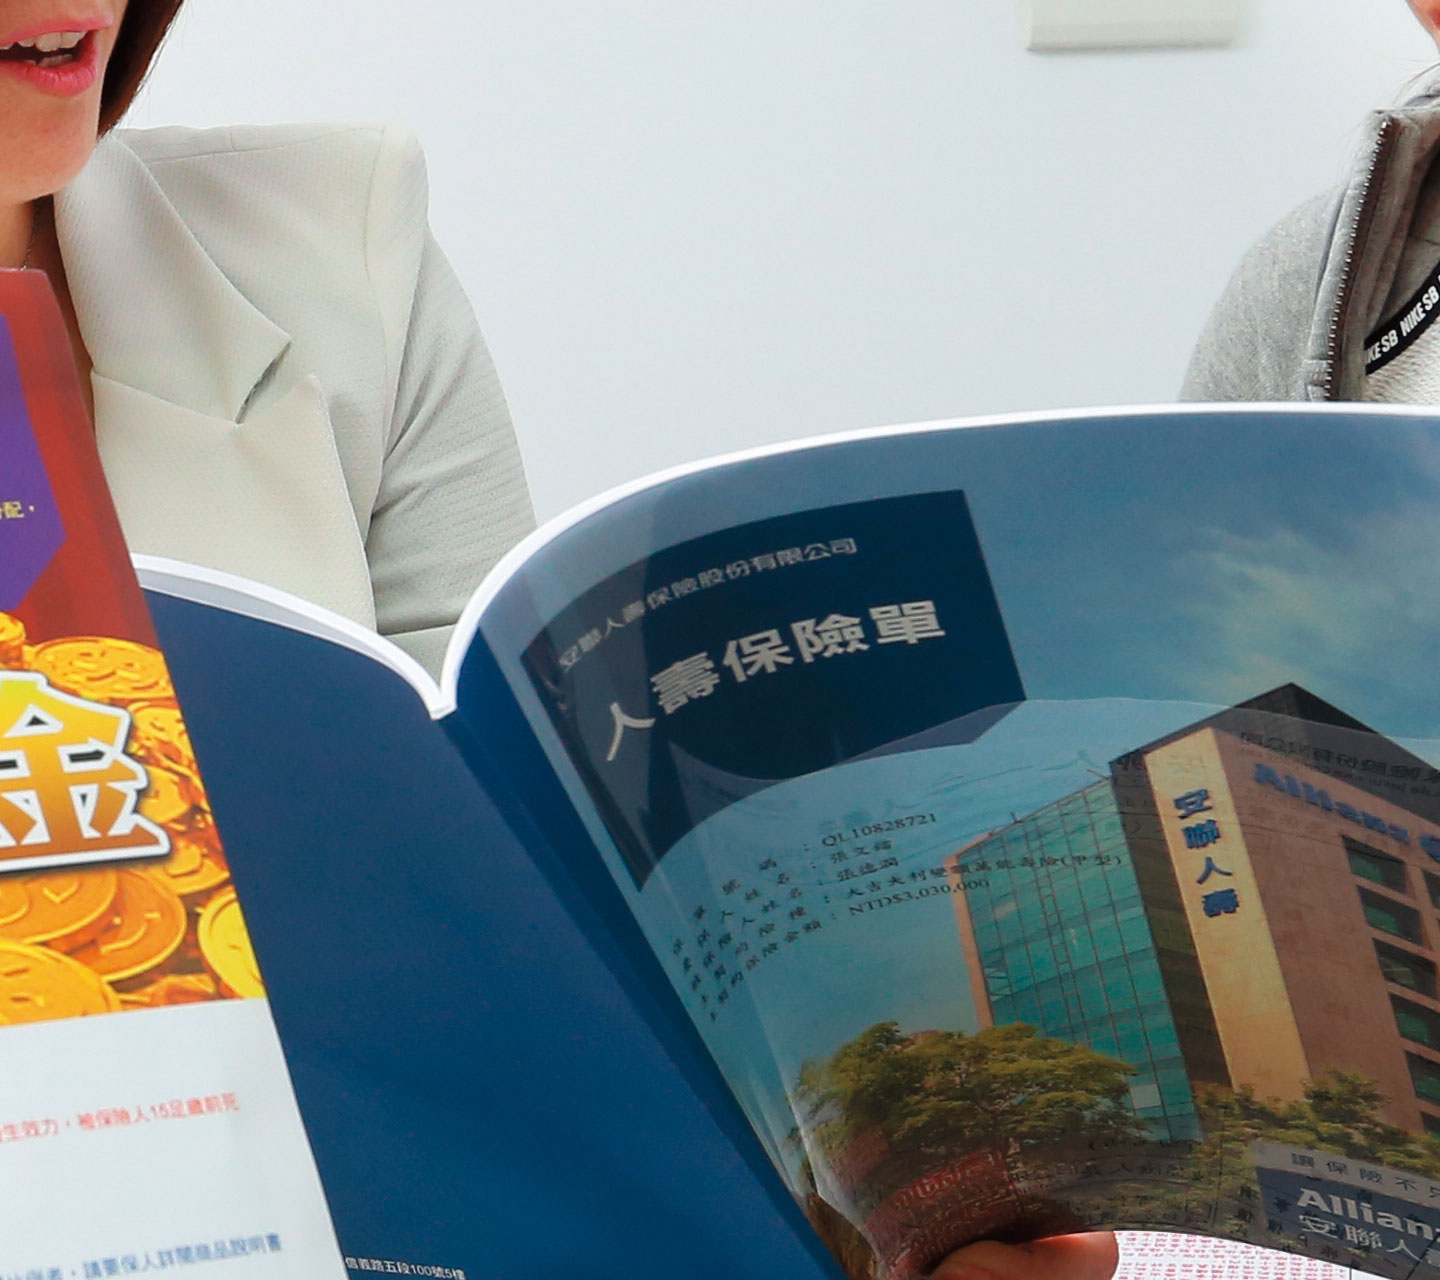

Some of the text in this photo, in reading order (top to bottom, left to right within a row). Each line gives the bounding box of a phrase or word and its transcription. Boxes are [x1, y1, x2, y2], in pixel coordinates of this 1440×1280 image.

[1367, 343, 1382, 363] KE
[1381, 329, 1399, 353] SB
[1400, 302, 1426, 337] NIKE
[1422, 285, 1440, 311] SB
[606, 600, 946, 762] 人壽保險單
[1173, 787, 1240, 918] 安聯人壽
